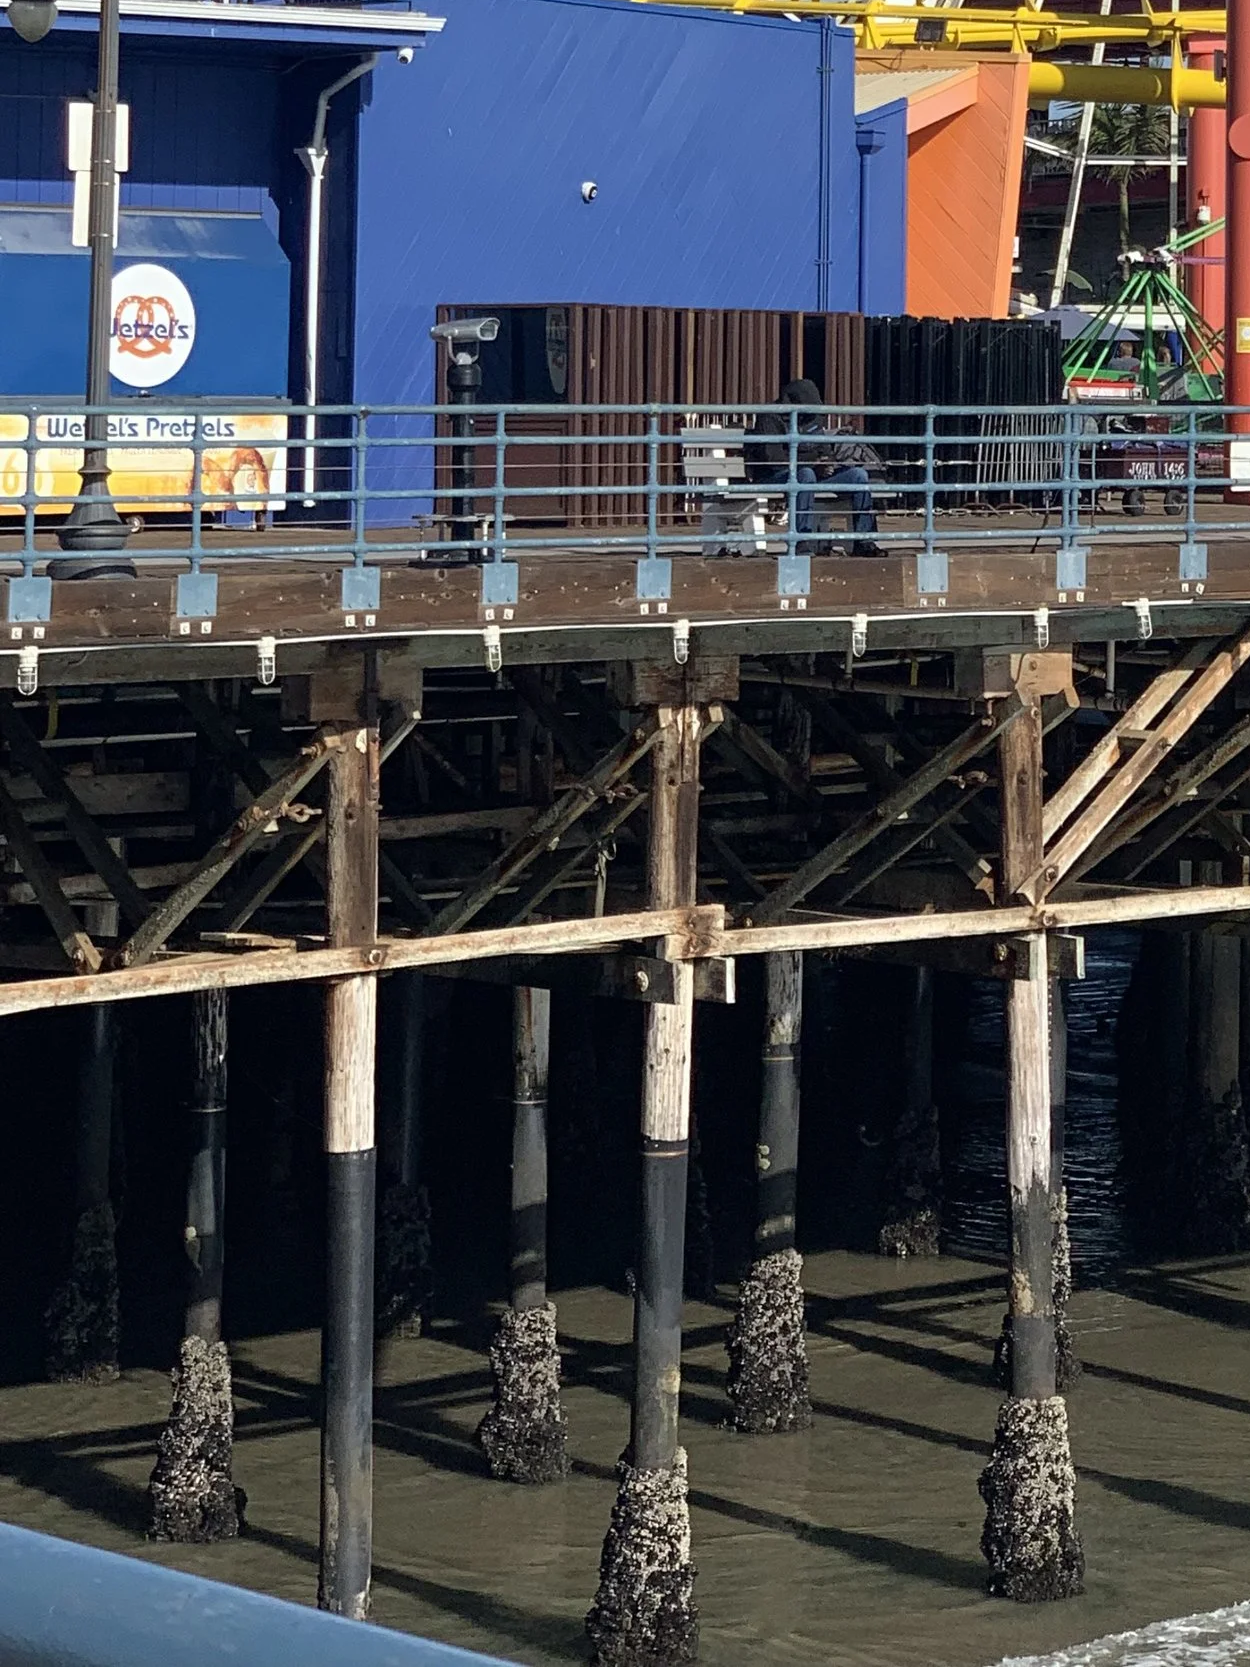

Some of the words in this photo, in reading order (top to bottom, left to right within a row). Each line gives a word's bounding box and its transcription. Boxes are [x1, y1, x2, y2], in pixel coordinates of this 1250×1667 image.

[47, 417, 139, 438] Weel's
[1128, 462, 1157, 476] JOHN
[1163, 461, 1185, 476] 14:6
